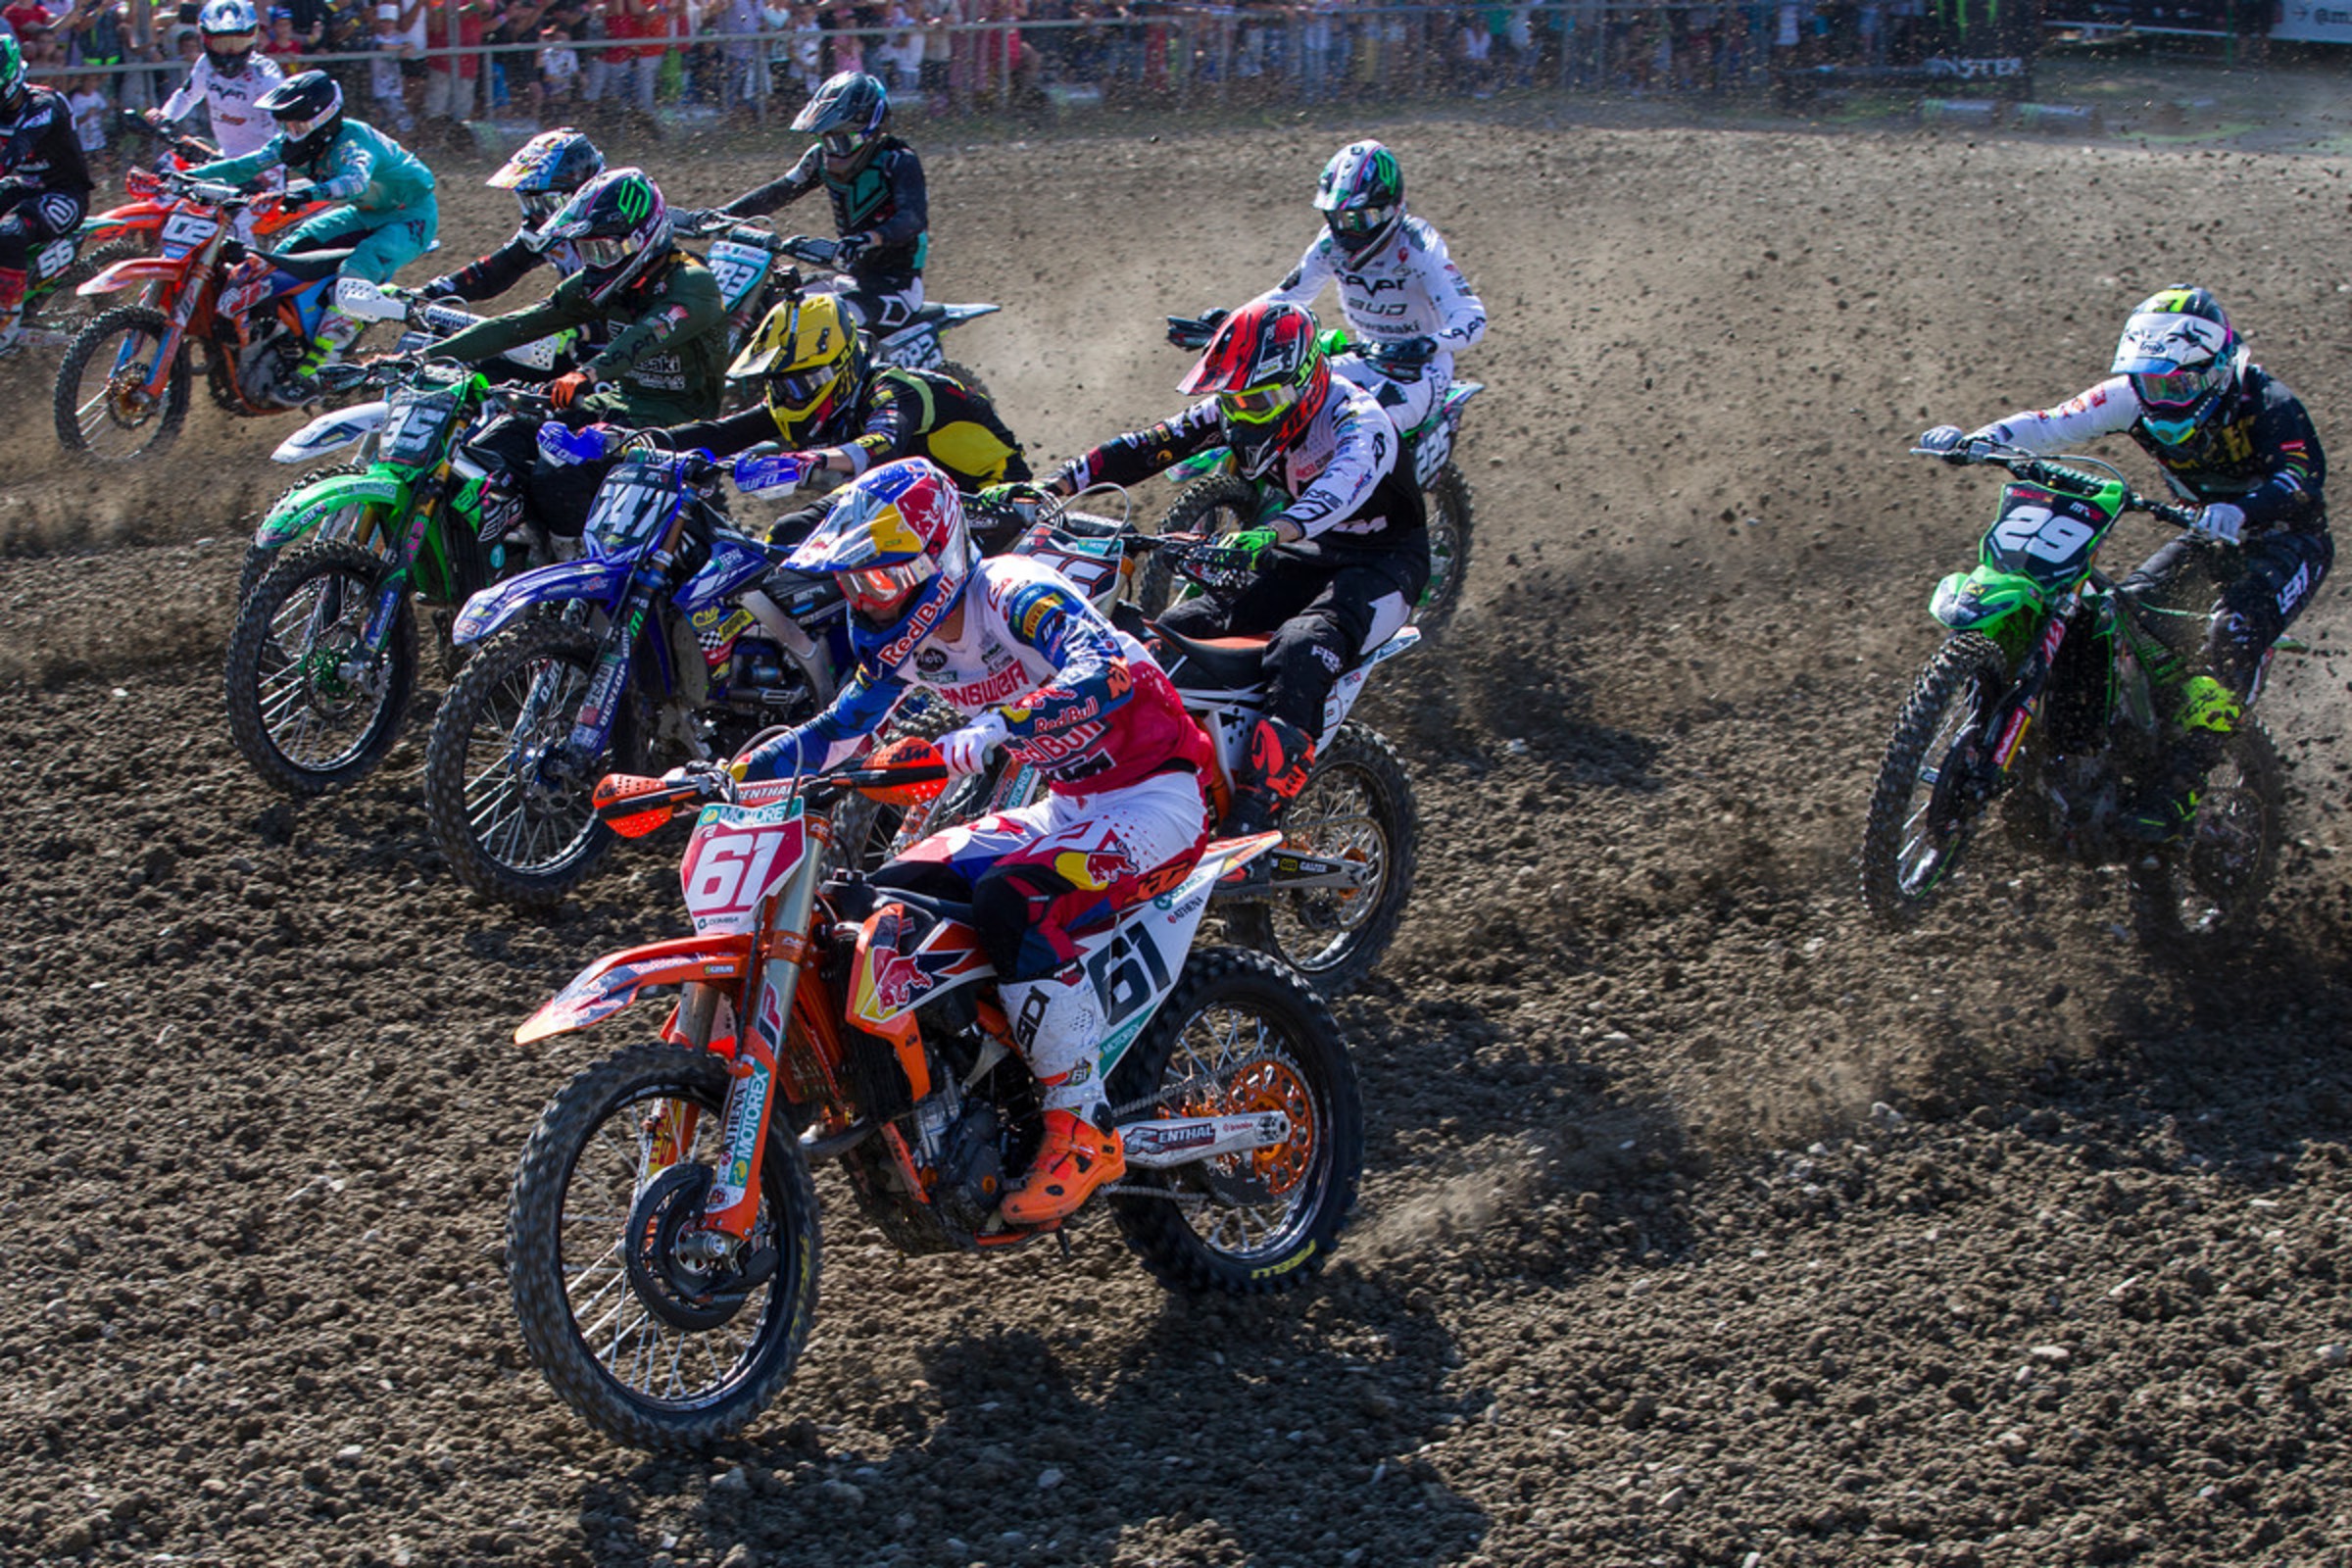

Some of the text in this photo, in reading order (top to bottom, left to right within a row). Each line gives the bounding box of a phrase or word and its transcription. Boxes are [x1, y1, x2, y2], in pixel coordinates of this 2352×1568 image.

[36, 240, 75, 279] 56
[1992, 505, 2095, 564] 29
[878, 619, 925, 667] Red
[915, 575, 956, 621] Bull
[599, 662, 627, 728] DUNLOP
[1035, 696, 1101, 733] Red Bull
[889, 745, 930, 762] KTM
[1039, 720, 1105, 761] Bull
[686, 833, 786, 912] 61
[1087, 921, 1172, 1026] 61
[737, 1069, 770, 1158] MOTOREX
[1124, 1124, 1215, 1154] RENTHAL
